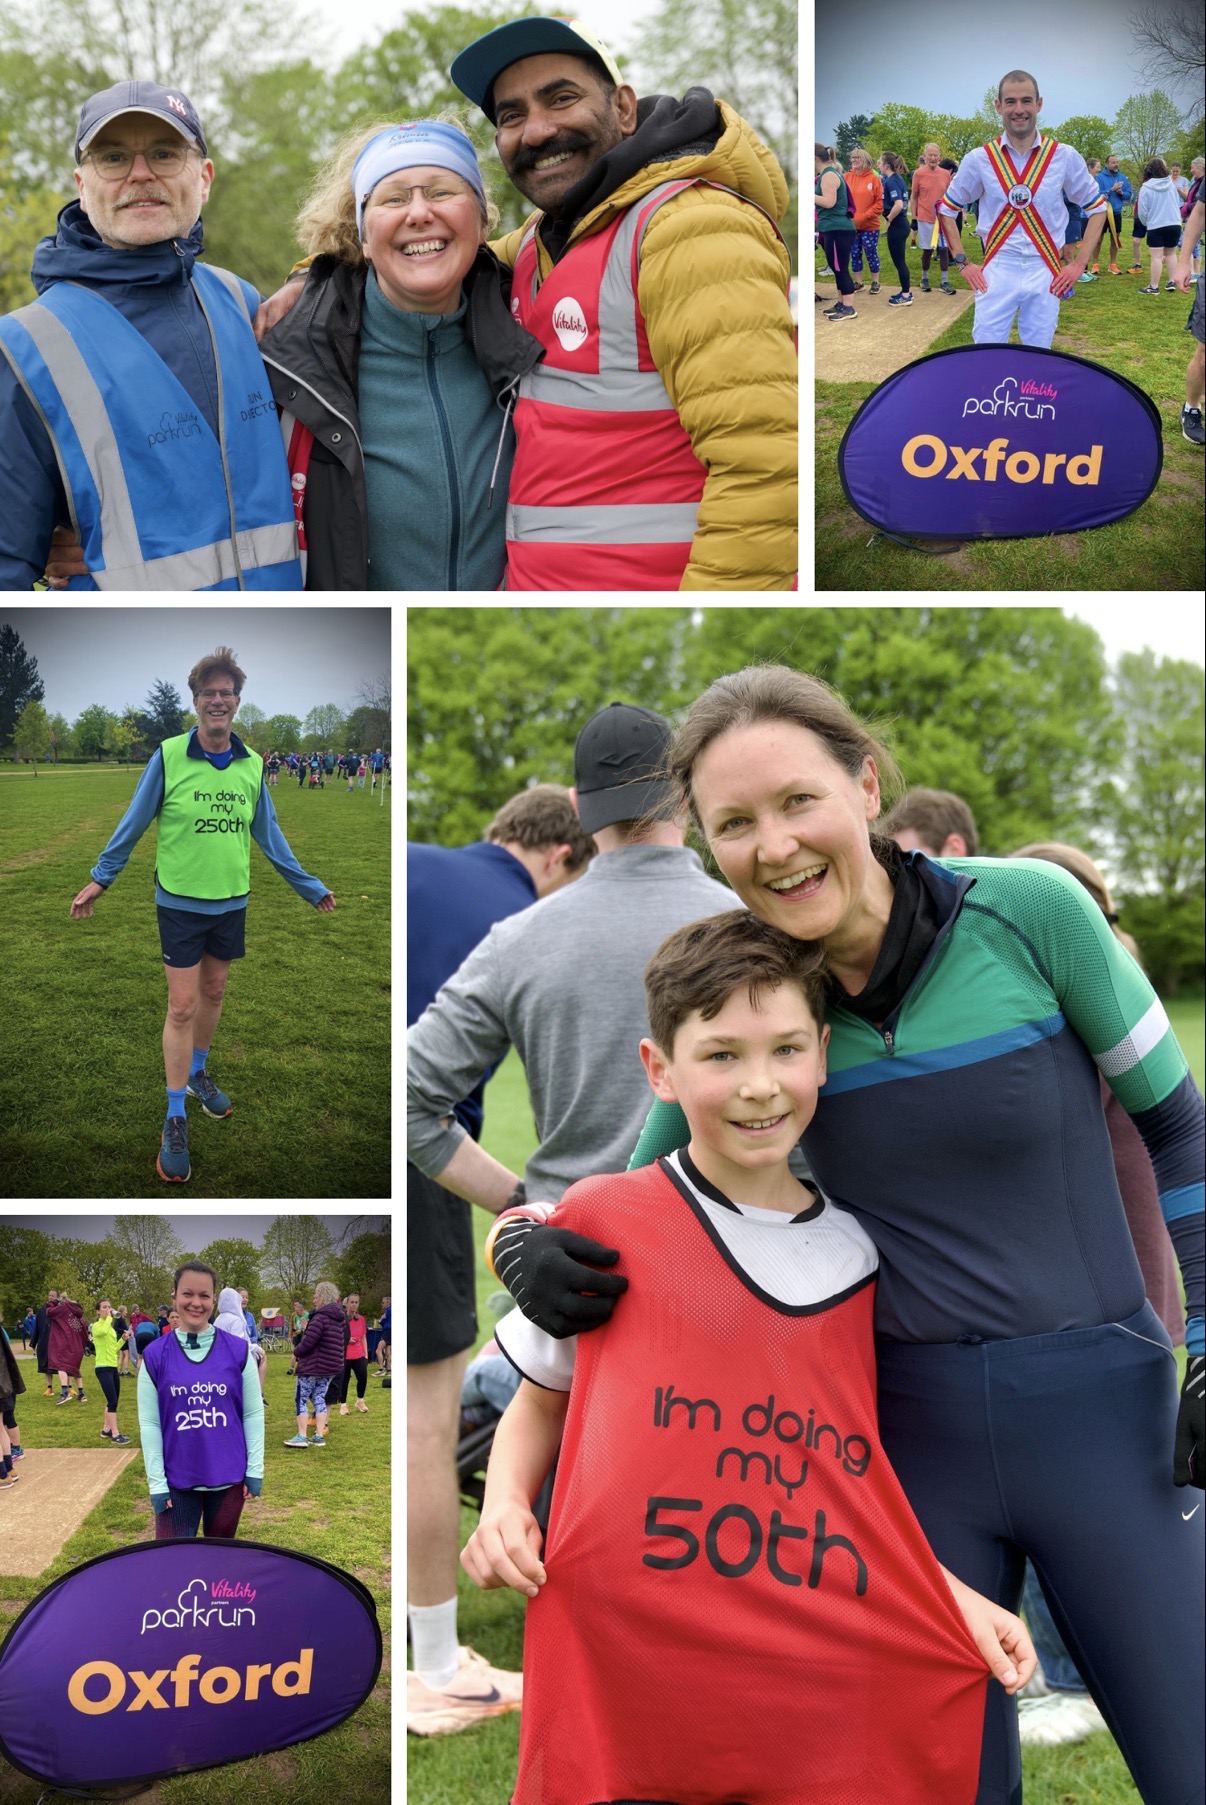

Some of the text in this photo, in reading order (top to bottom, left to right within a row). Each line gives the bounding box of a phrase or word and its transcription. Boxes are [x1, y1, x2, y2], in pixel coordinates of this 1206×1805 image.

[553, 310, 587, 340] Vitality
[1020, 378, 1058, 402] Vitality
[962, 387, 1056, 421] parkrun
[147, 421, 202, 448] parkrun
[901, 434, 1104, 486] Oxford
[194, 789, 246, 805] I'm doing
[210, 803, 233, 815] my
[194, 817, 244, 833] 250th
[170, 1381, 227, 1397] I'm doing
[187, 1395, 211, 1407] my
[175, 1406, 227, 1431] 25th
[654, 1385, 872, 1478] I'm doing
[715, 1447, 809, 1500] my
[642, 1496, 868, 1596] 50th
[211, 1578, 257, 1604] Vitality
[140, 1592, 256, 1635] parkrun
[67, 1648, 315, 1716] Oxford
